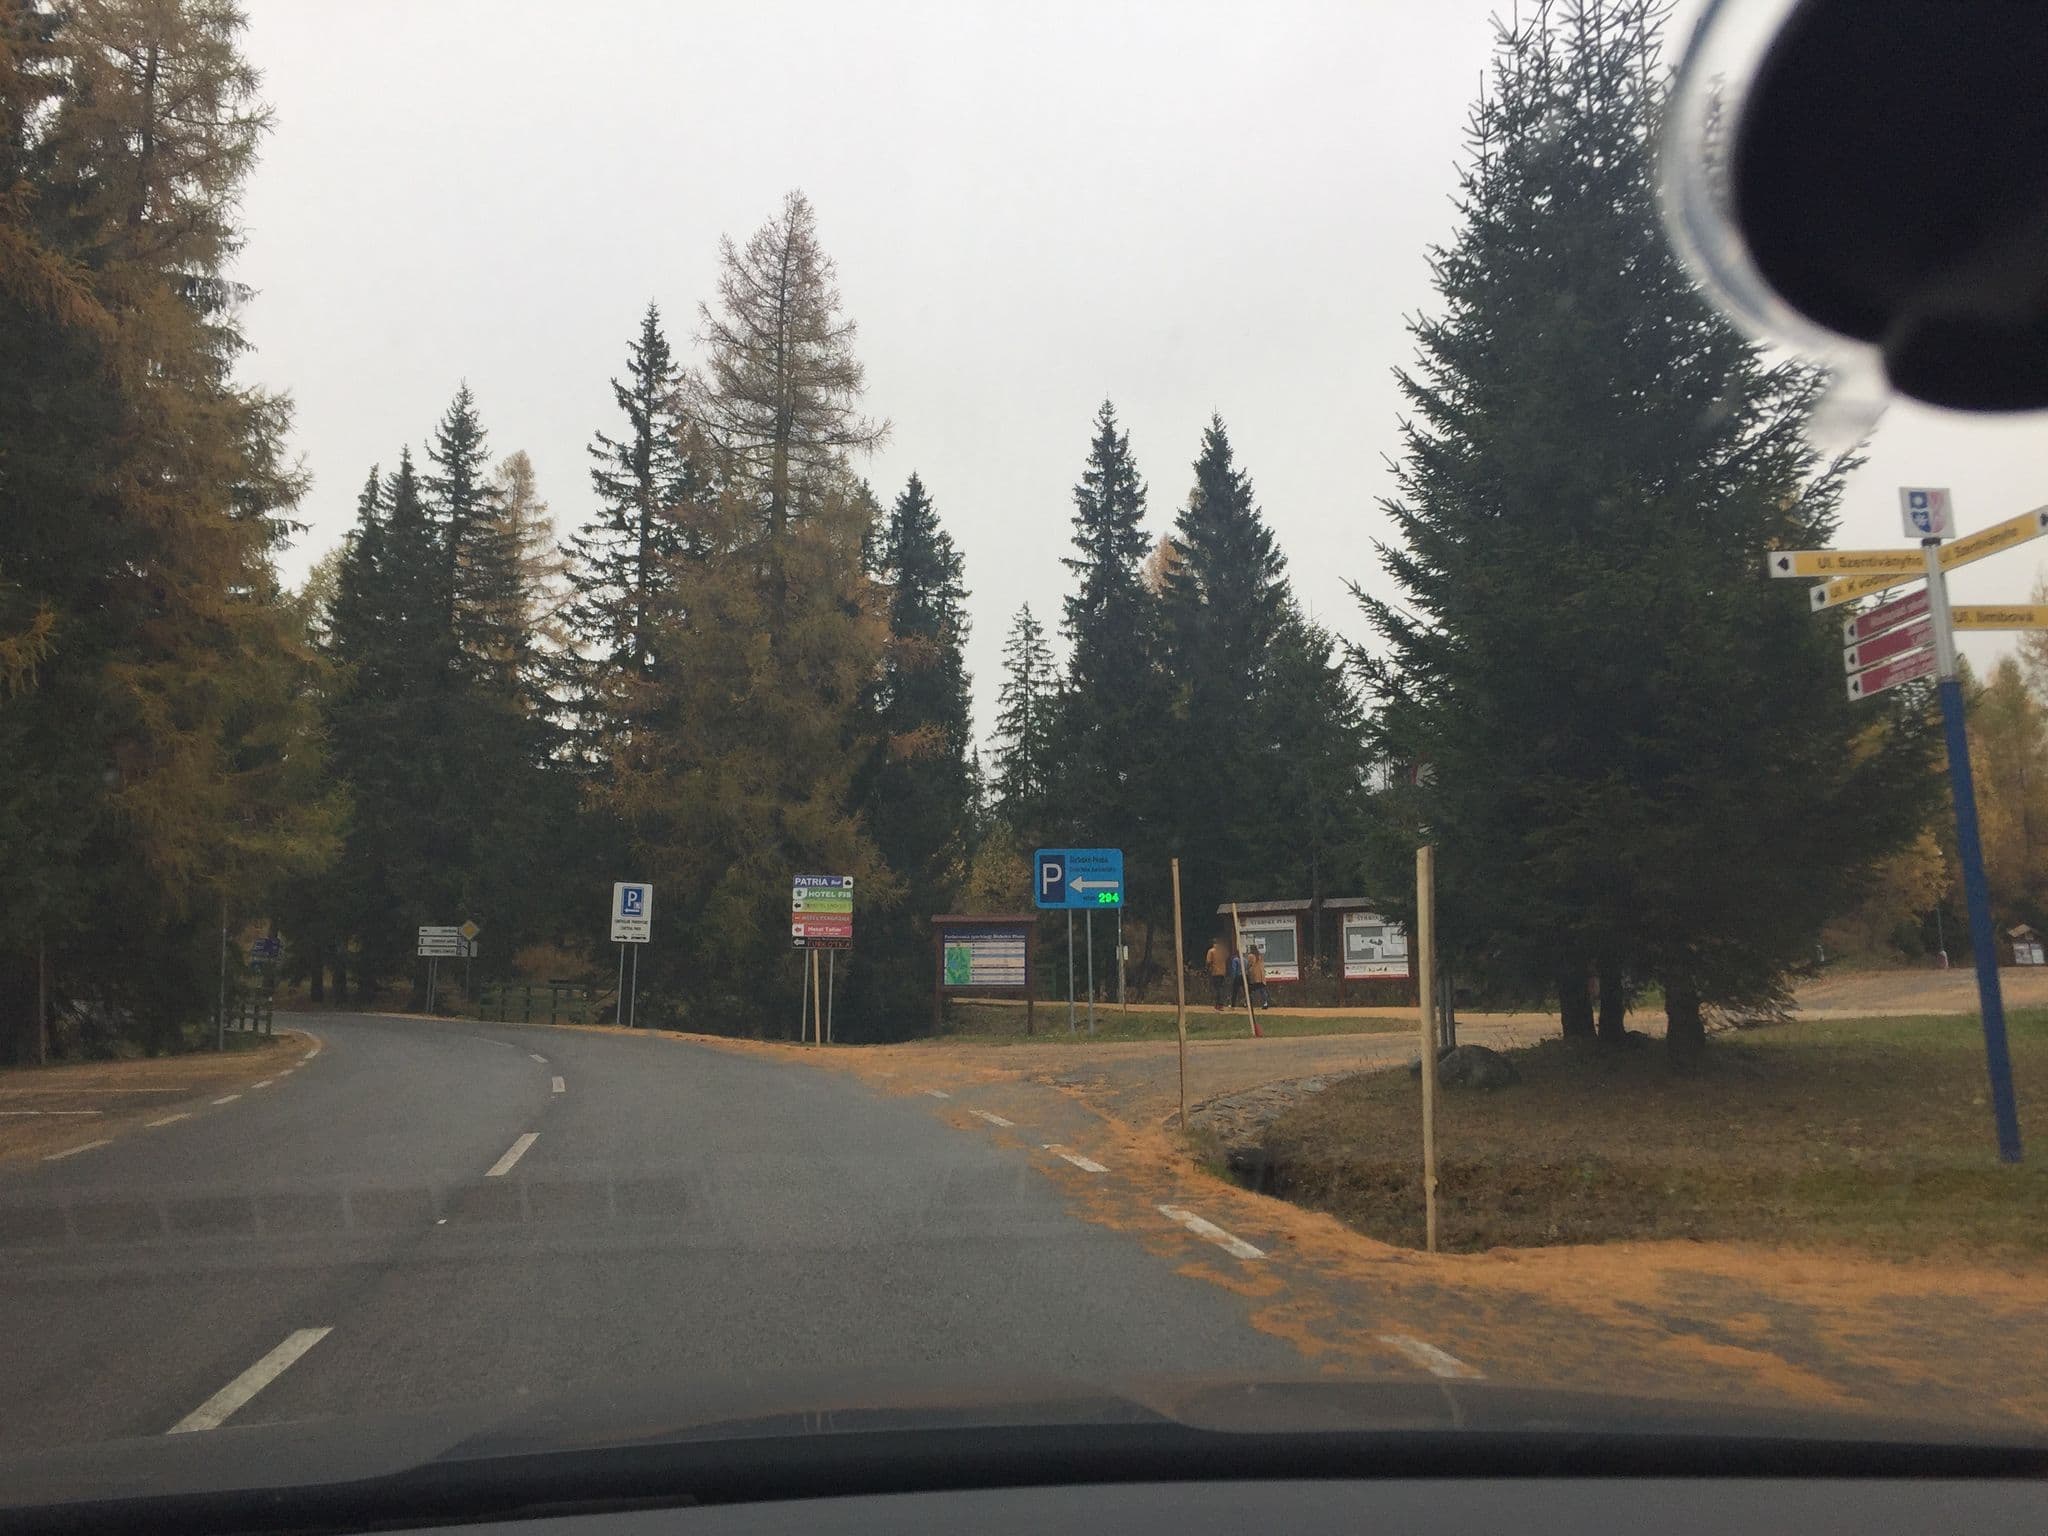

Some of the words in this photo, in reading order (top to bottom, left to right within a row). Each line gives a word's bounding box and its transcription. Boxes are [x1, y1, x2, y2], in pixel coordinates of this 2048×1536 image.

[795, 877, 828, 886] PATRIA
[1043, 863, 1063, 895] P
[628, 890, 638, 907] P
[808, 891, 837, 899] HOTEL
